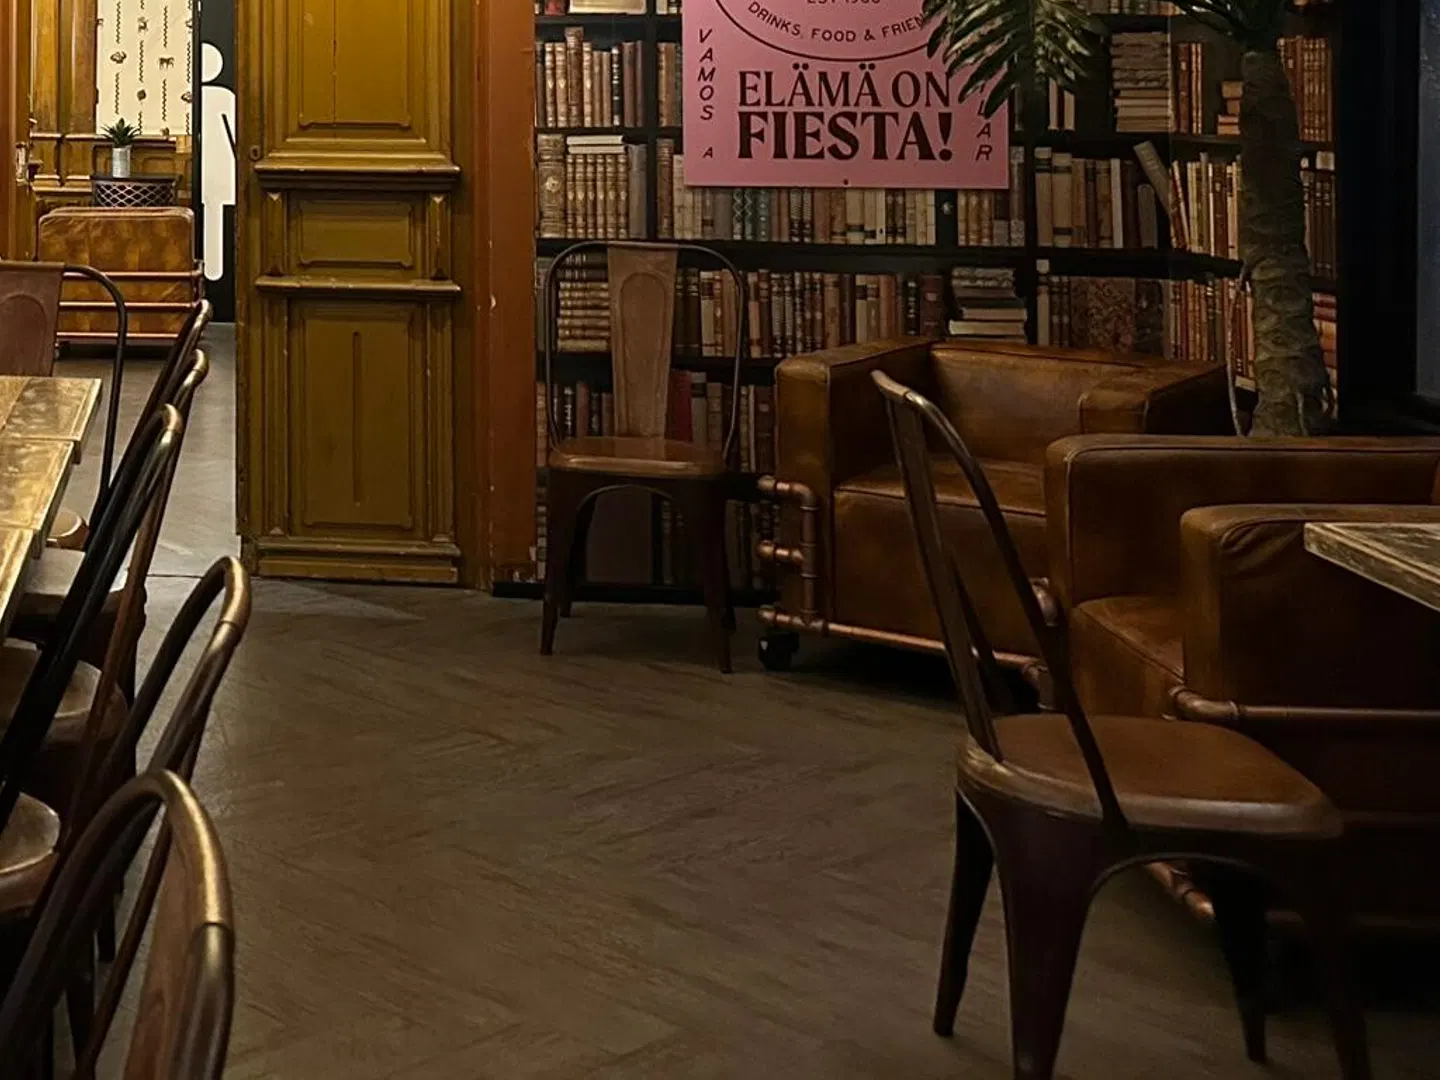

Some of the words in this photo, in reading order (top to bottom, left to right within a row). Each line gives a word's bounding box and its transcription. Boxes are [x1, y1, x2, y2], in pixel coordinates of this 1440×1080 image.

[810, 27, 857, 42] FOOD
[863, 28, 876, 41] &
[881, 12, 924, 39] FRIEN
[697, 28, 717, 121] VAMOS
[738, 62, 883, 107] ELÄMÄ
[891, 70, 951, 108] ON
[702, 146, 713, 159] A
[737, 110, 953, 161] FIESTA!
